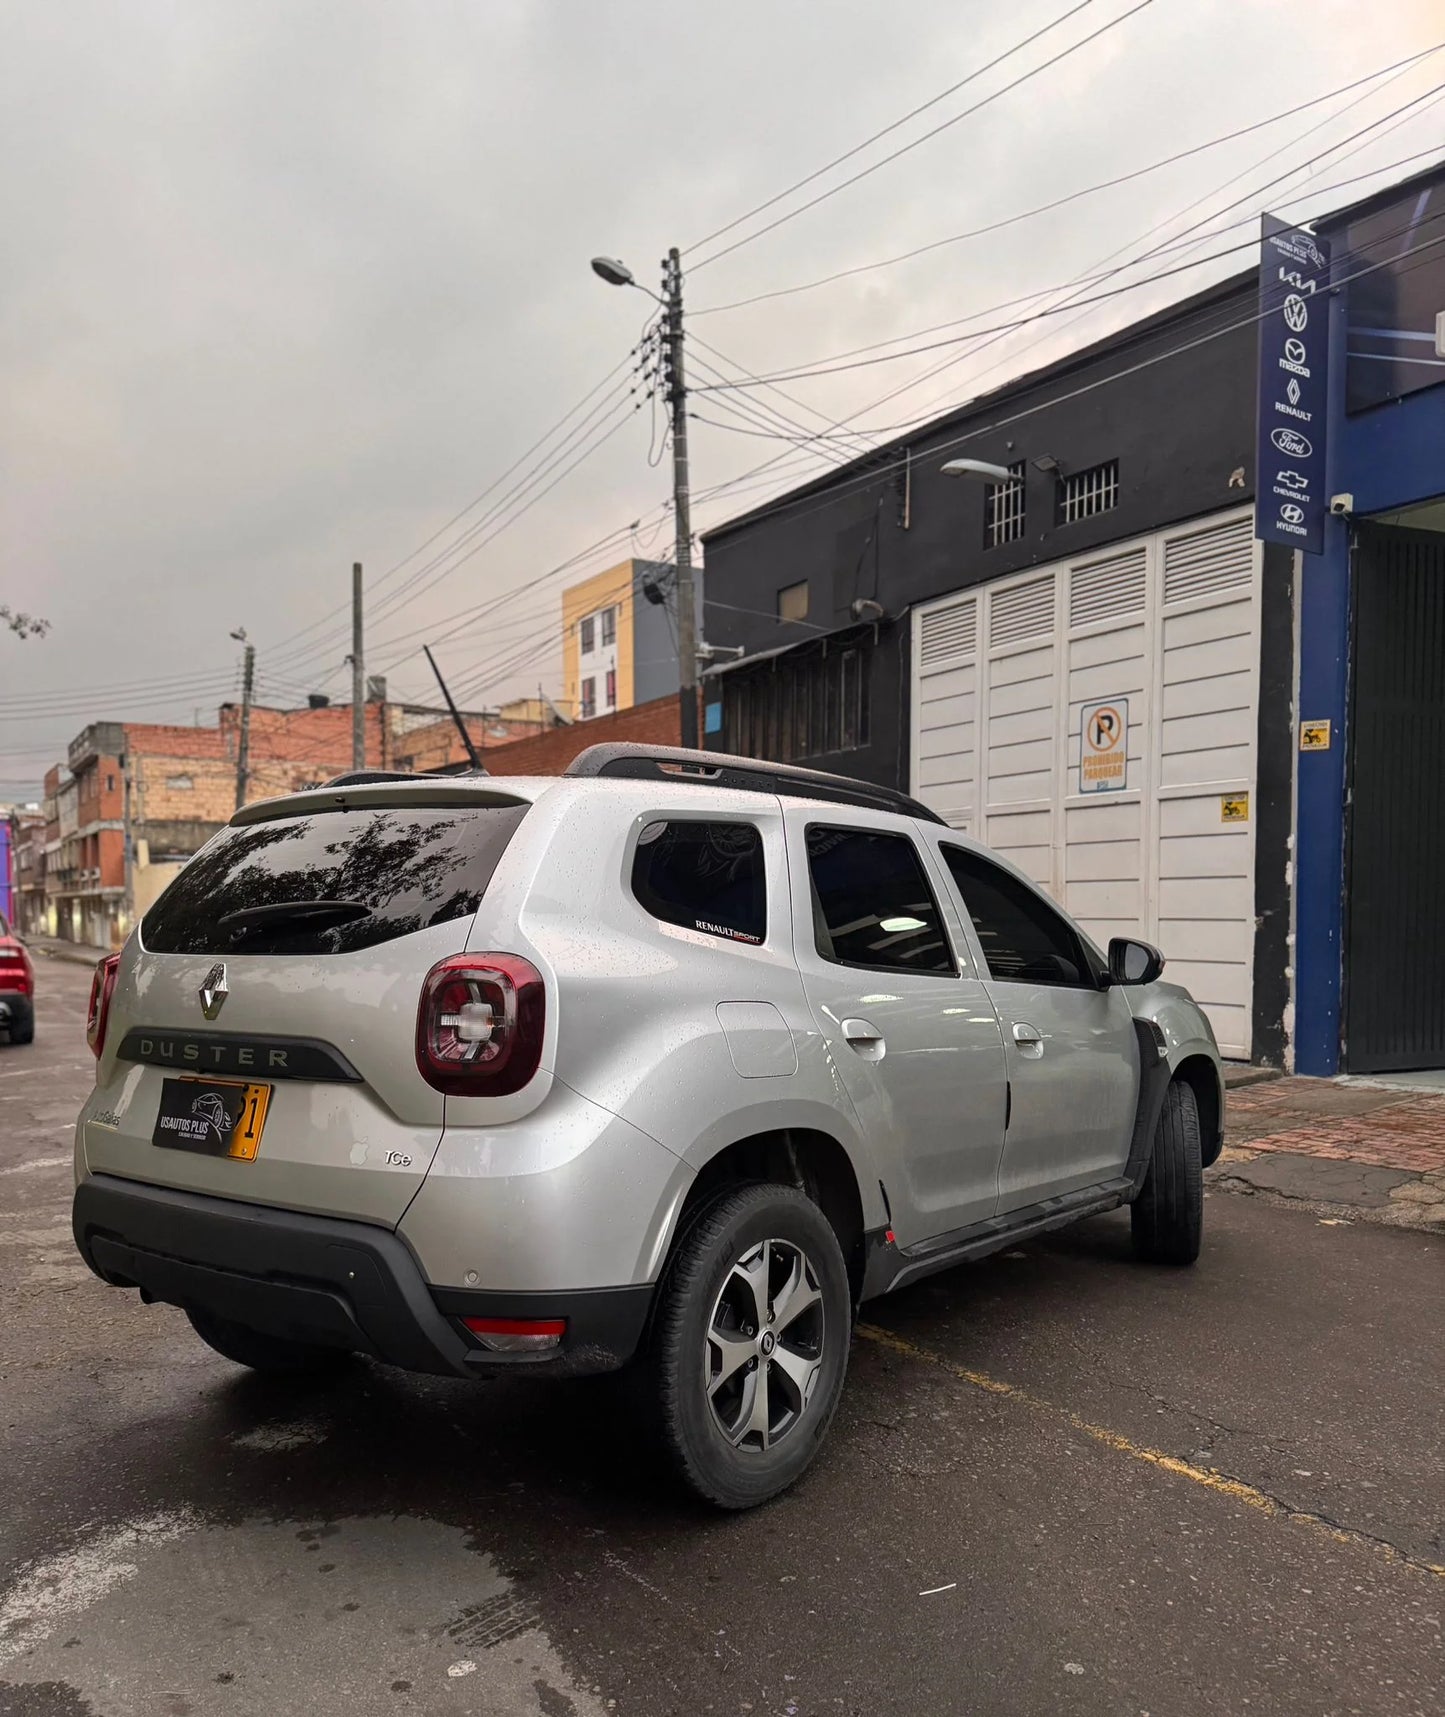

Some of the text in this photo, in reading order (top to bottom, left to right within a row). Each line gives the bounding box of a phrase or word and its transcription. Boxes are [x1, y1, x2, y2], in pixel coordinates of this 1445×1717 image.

[1279, 267, 1316, 294] KIA
[1275, 402, 1312, 422] RENAULT
[1279, 432, 1305, 454] Ford
[1273, 486, 1310, 502] CHEVROLET
[1276, 521, 1307, 536] HYUNDAI
[140, 1039, 288, 1067] DUSTER
[160, 1116, 209, 1134] USAUTOS PLUS
[385, 1150, 412, 1167] TCe
